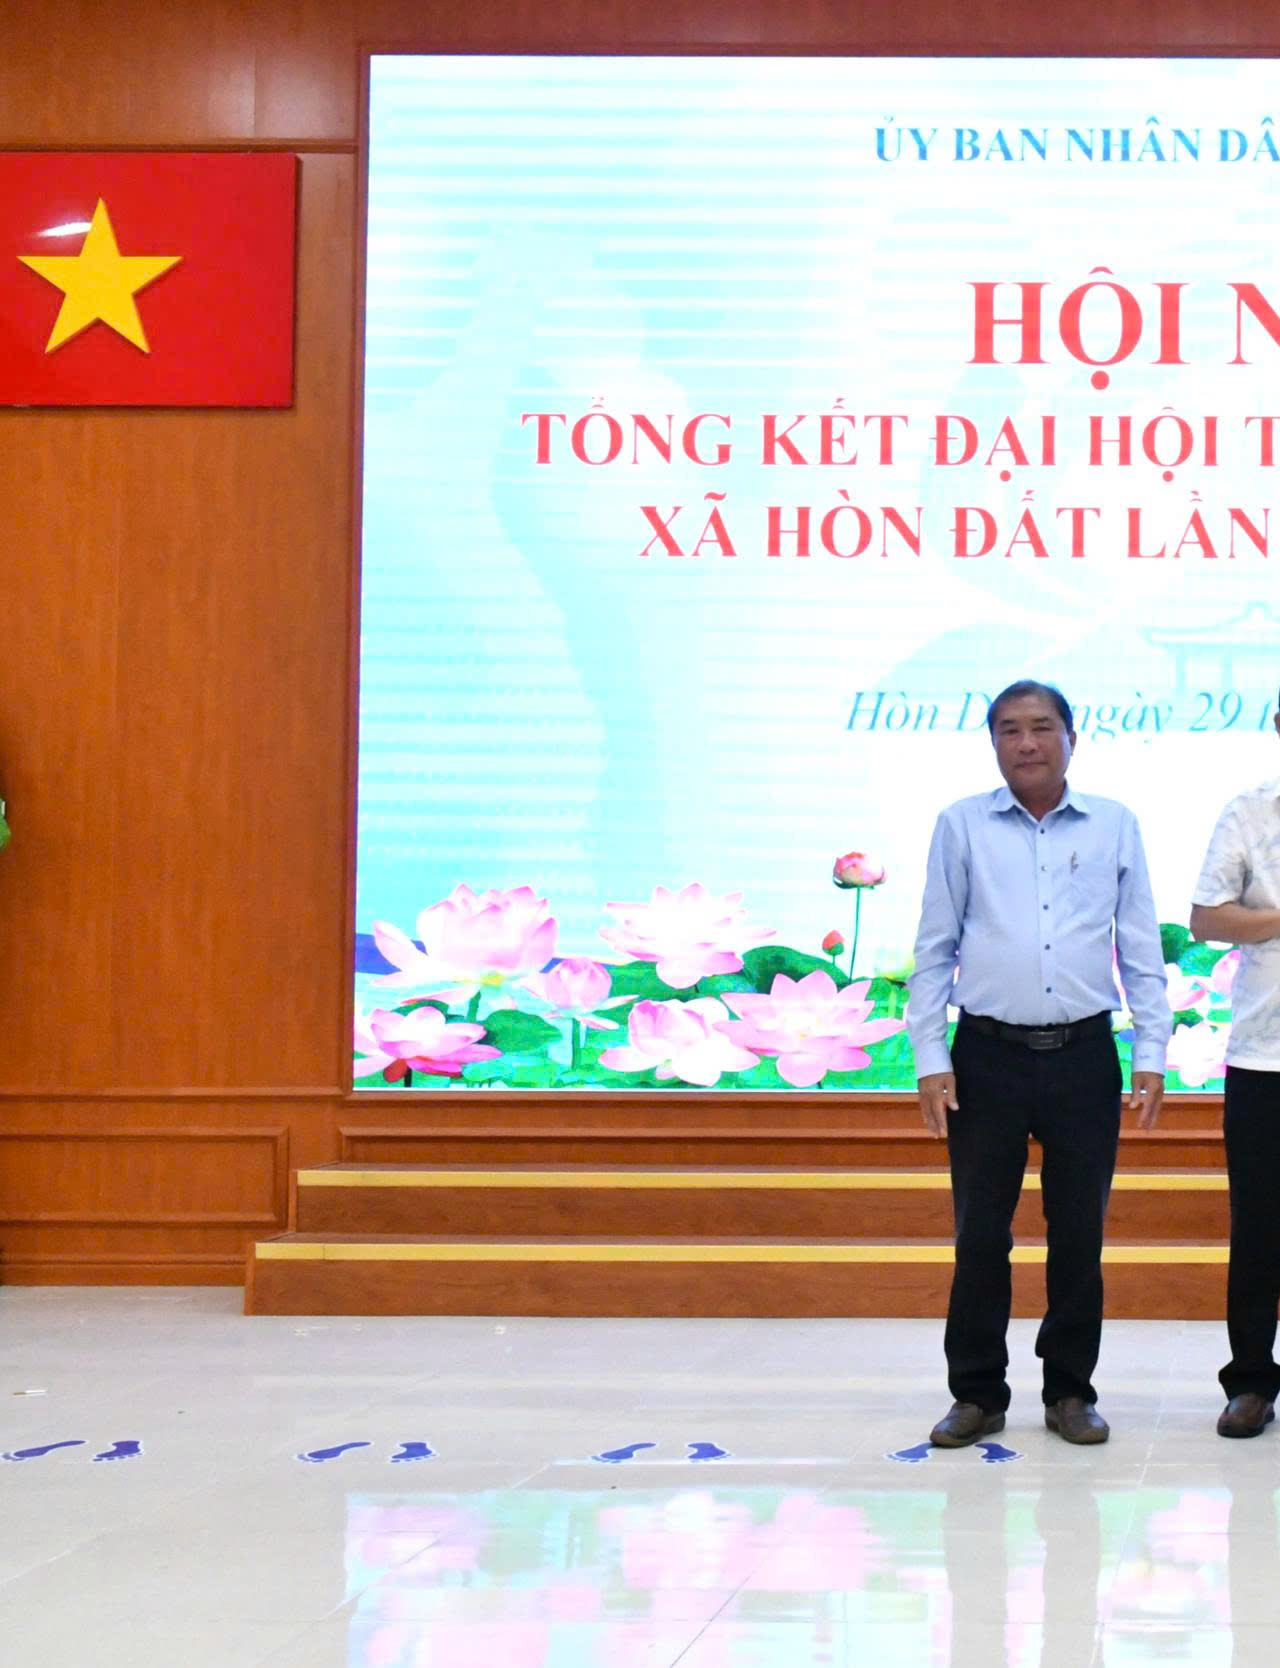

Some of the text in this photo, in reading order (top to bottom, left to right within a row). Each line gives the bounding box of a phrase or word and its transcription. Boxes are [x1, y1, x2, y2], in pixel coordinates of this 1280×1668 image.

[874, 115, 937, 162] ỦY
[954, 127, 1048, 162] BAN
[1065, 115, 1201, 162] NHÂN
[966, 265, 1190, 391] HỘI
[521, 397, 732, 467] TỔNG
[761, 397, 909, 467] KẾT
[930, 415, 1057, 482] ĐẠI
[1088, 406, 1218, 483] HỘI
[639, 491, 738, 558] XÃ
[766, 488, 924, 559] HÒN
[949, 489, 1102, 559] ĐẤT
[1126, 490, 1270, 560] LẦN
[846, 690, 940, 731] Hòn
[1071, 690, 1174, 743] ngày
[1187, 690, 1243, 732] 29
